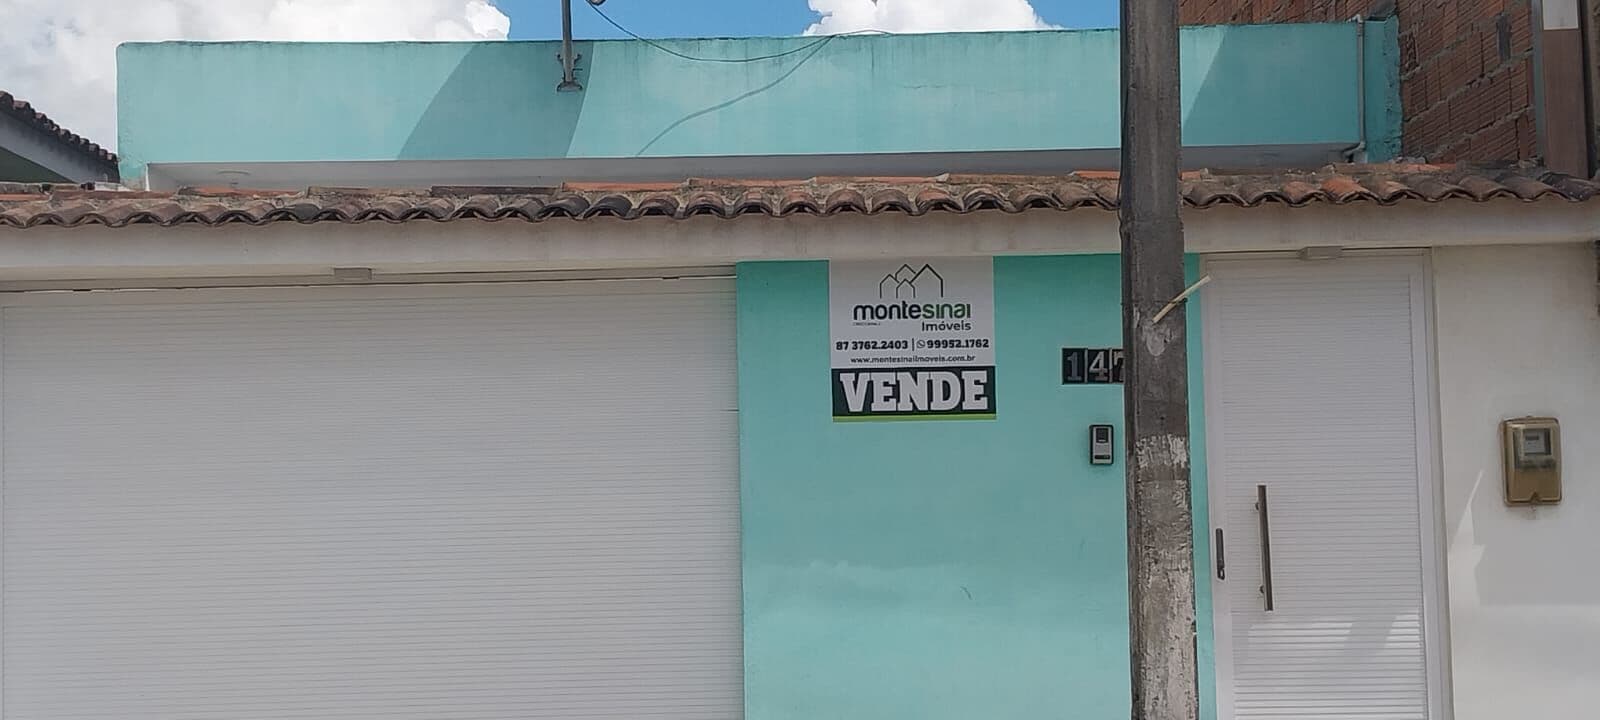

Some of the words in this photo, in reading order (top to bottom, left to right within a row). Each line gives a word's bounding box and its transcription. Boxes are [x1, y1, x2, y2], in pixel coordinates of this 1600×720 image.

[921, 320, 971, 332] Imóveis
[836, 341, 849, 350] 87
[852, 340, 908, 350] 3762.2403
[927, 338, 989, 349] 99952.1762
[839, 370, 988, 412] VENDE
